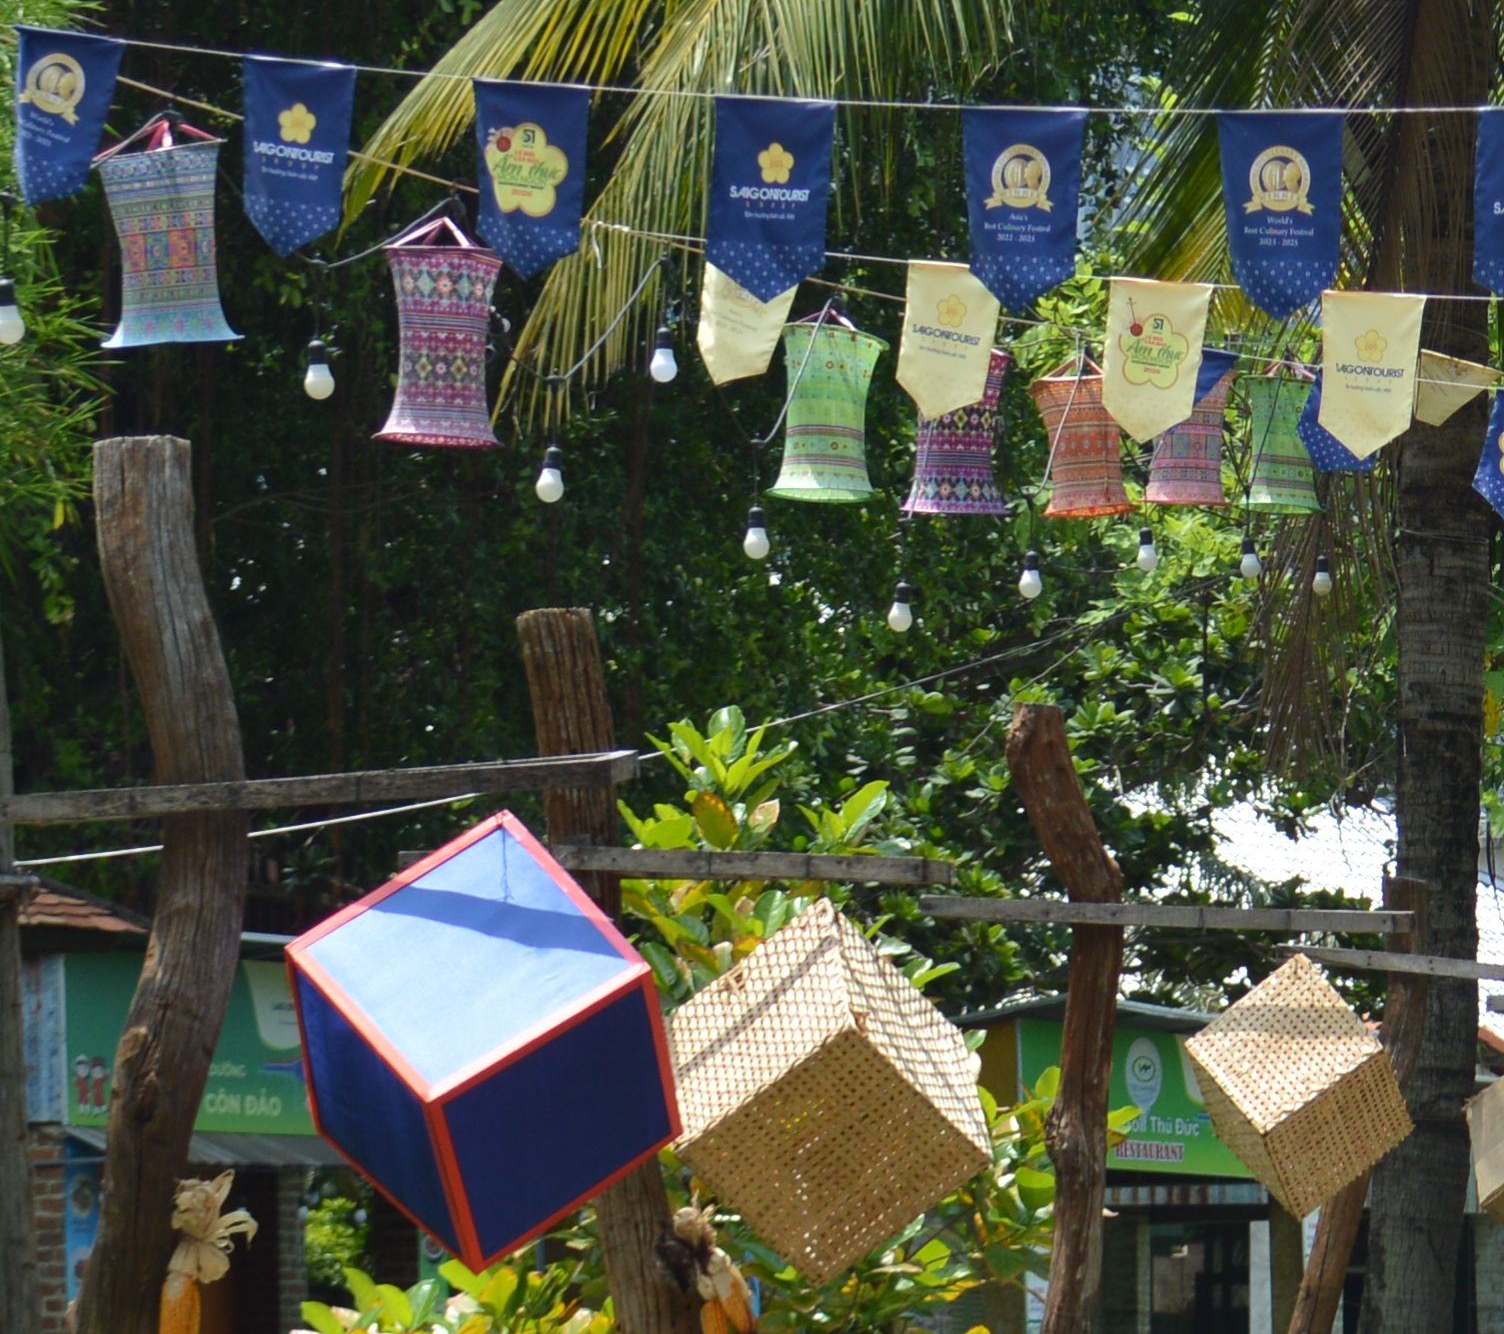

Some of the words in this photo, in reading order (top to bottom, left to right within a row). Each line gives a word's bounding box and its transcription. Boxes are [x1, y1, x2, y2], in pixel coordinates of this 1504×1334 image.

[729, 185, 810, 202] SAIGONTOURIST
[984, 222, 996, 230] Best
[998, 223, 1025, 232] Culinary
[1027, 224, 1051, 232] Festival
[1267, 216, 1293, 224] World's
[1244, 227, 1258, 235] Best
[1259, 227, 1288, 236] Culinary
[1289, 228, 1314, 236] Festival
[912, 324, 980, 346] SAIGONTOURIST
[1336, 363, 1405, 377] SAIGONTOURIST
[206, 1088, 240, 1114] CÔN
[247, 1088, 282, 1115] ĐẢO
[1150, 1116, 1172, 1135] Thủ
[1175, 1117, 1200, 1137] Đức
[1116, 1143, 1184, 1160] RESTAURANT
